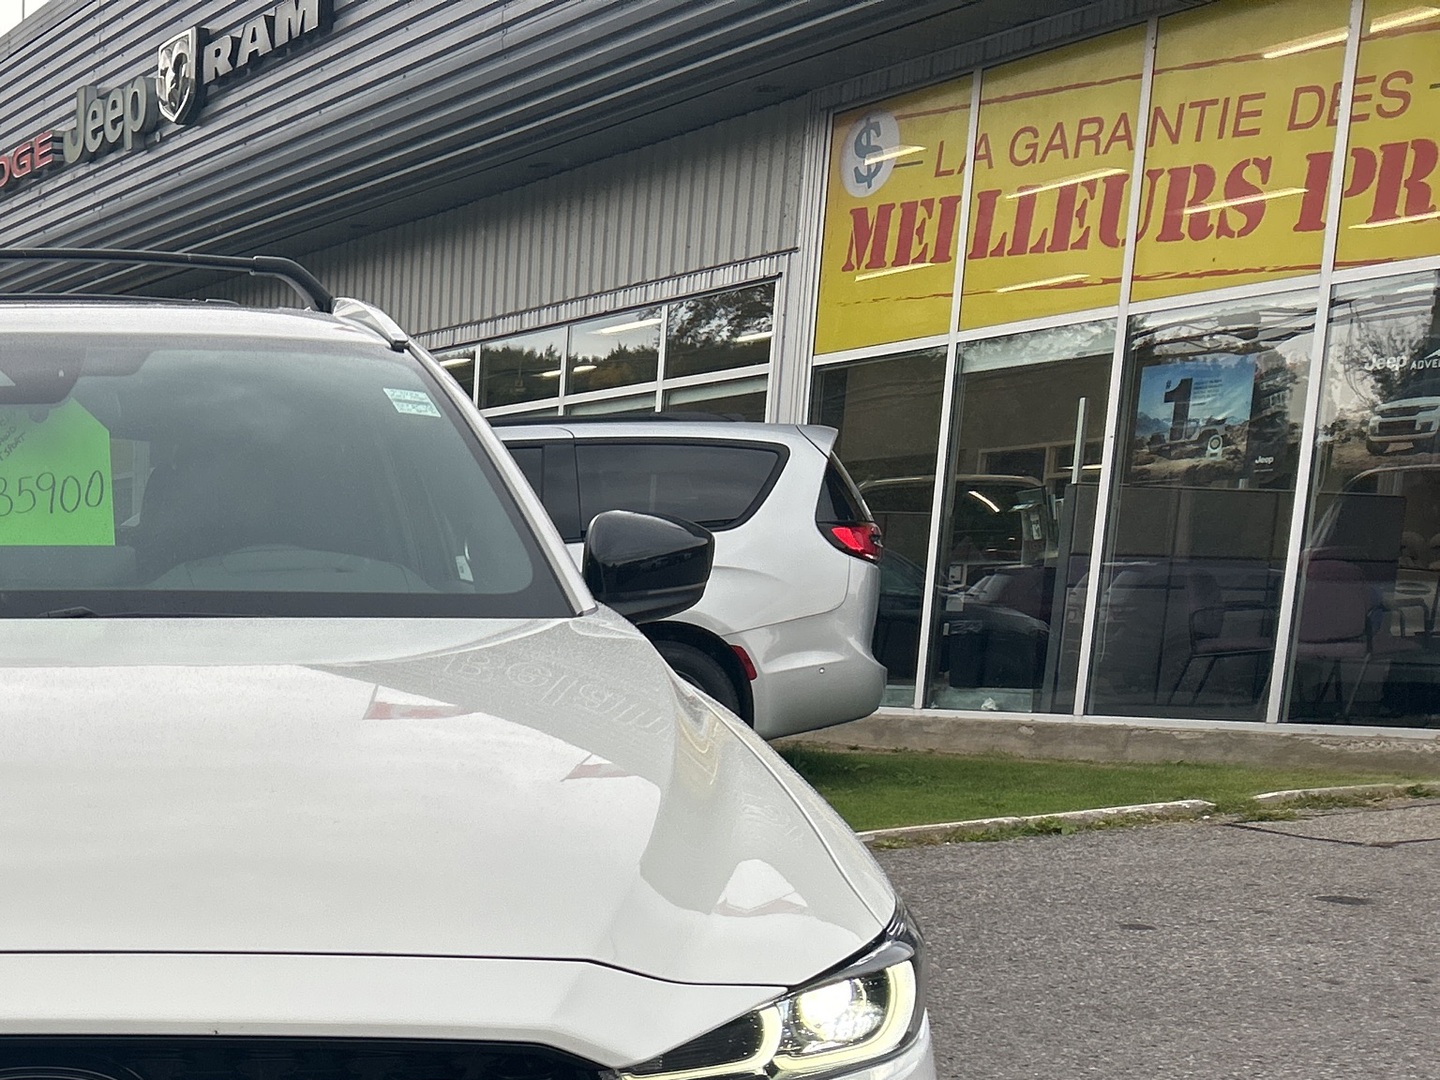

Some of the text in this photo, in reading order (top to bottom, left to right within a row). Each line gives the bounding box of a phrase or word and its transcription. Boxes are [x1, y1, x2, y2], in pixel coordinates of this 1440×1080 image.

[203, 0, 319, 84] RAM
[63, 76, 148, 163] Jeep
[934, 70, 1413, 178] LA GARANTIE DES
[842, 138, 1440, 271] MEILLEURS PR
[1364, 354, 1440, 371] Jeep ADVE
